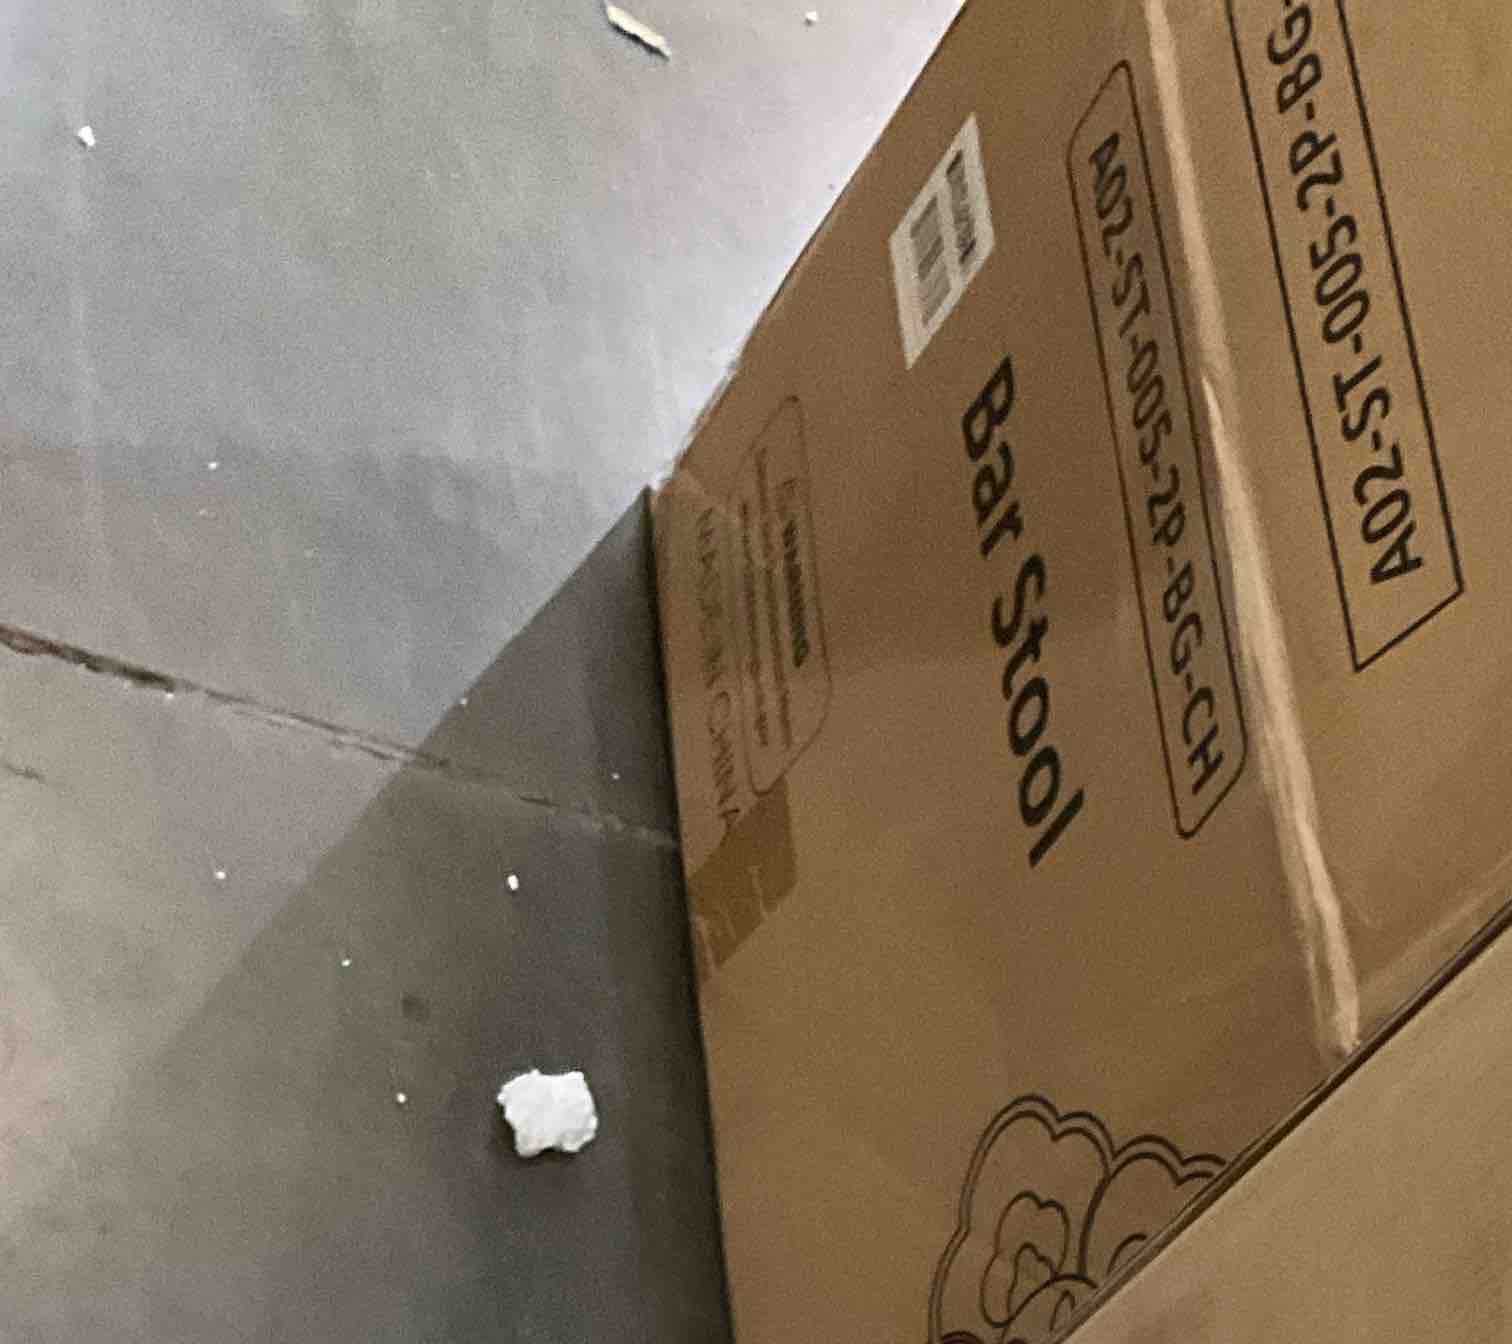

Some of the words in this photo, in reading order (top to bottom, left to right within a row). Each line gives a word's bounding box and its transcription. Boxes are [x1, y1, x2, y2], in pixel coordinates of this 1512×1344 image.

[961, 354, 1025, 560] Bar
[1087, 132, 1225, 796] A02-ST-005-2P-BG-CH
[991, 553, 1085, 869] Stool
